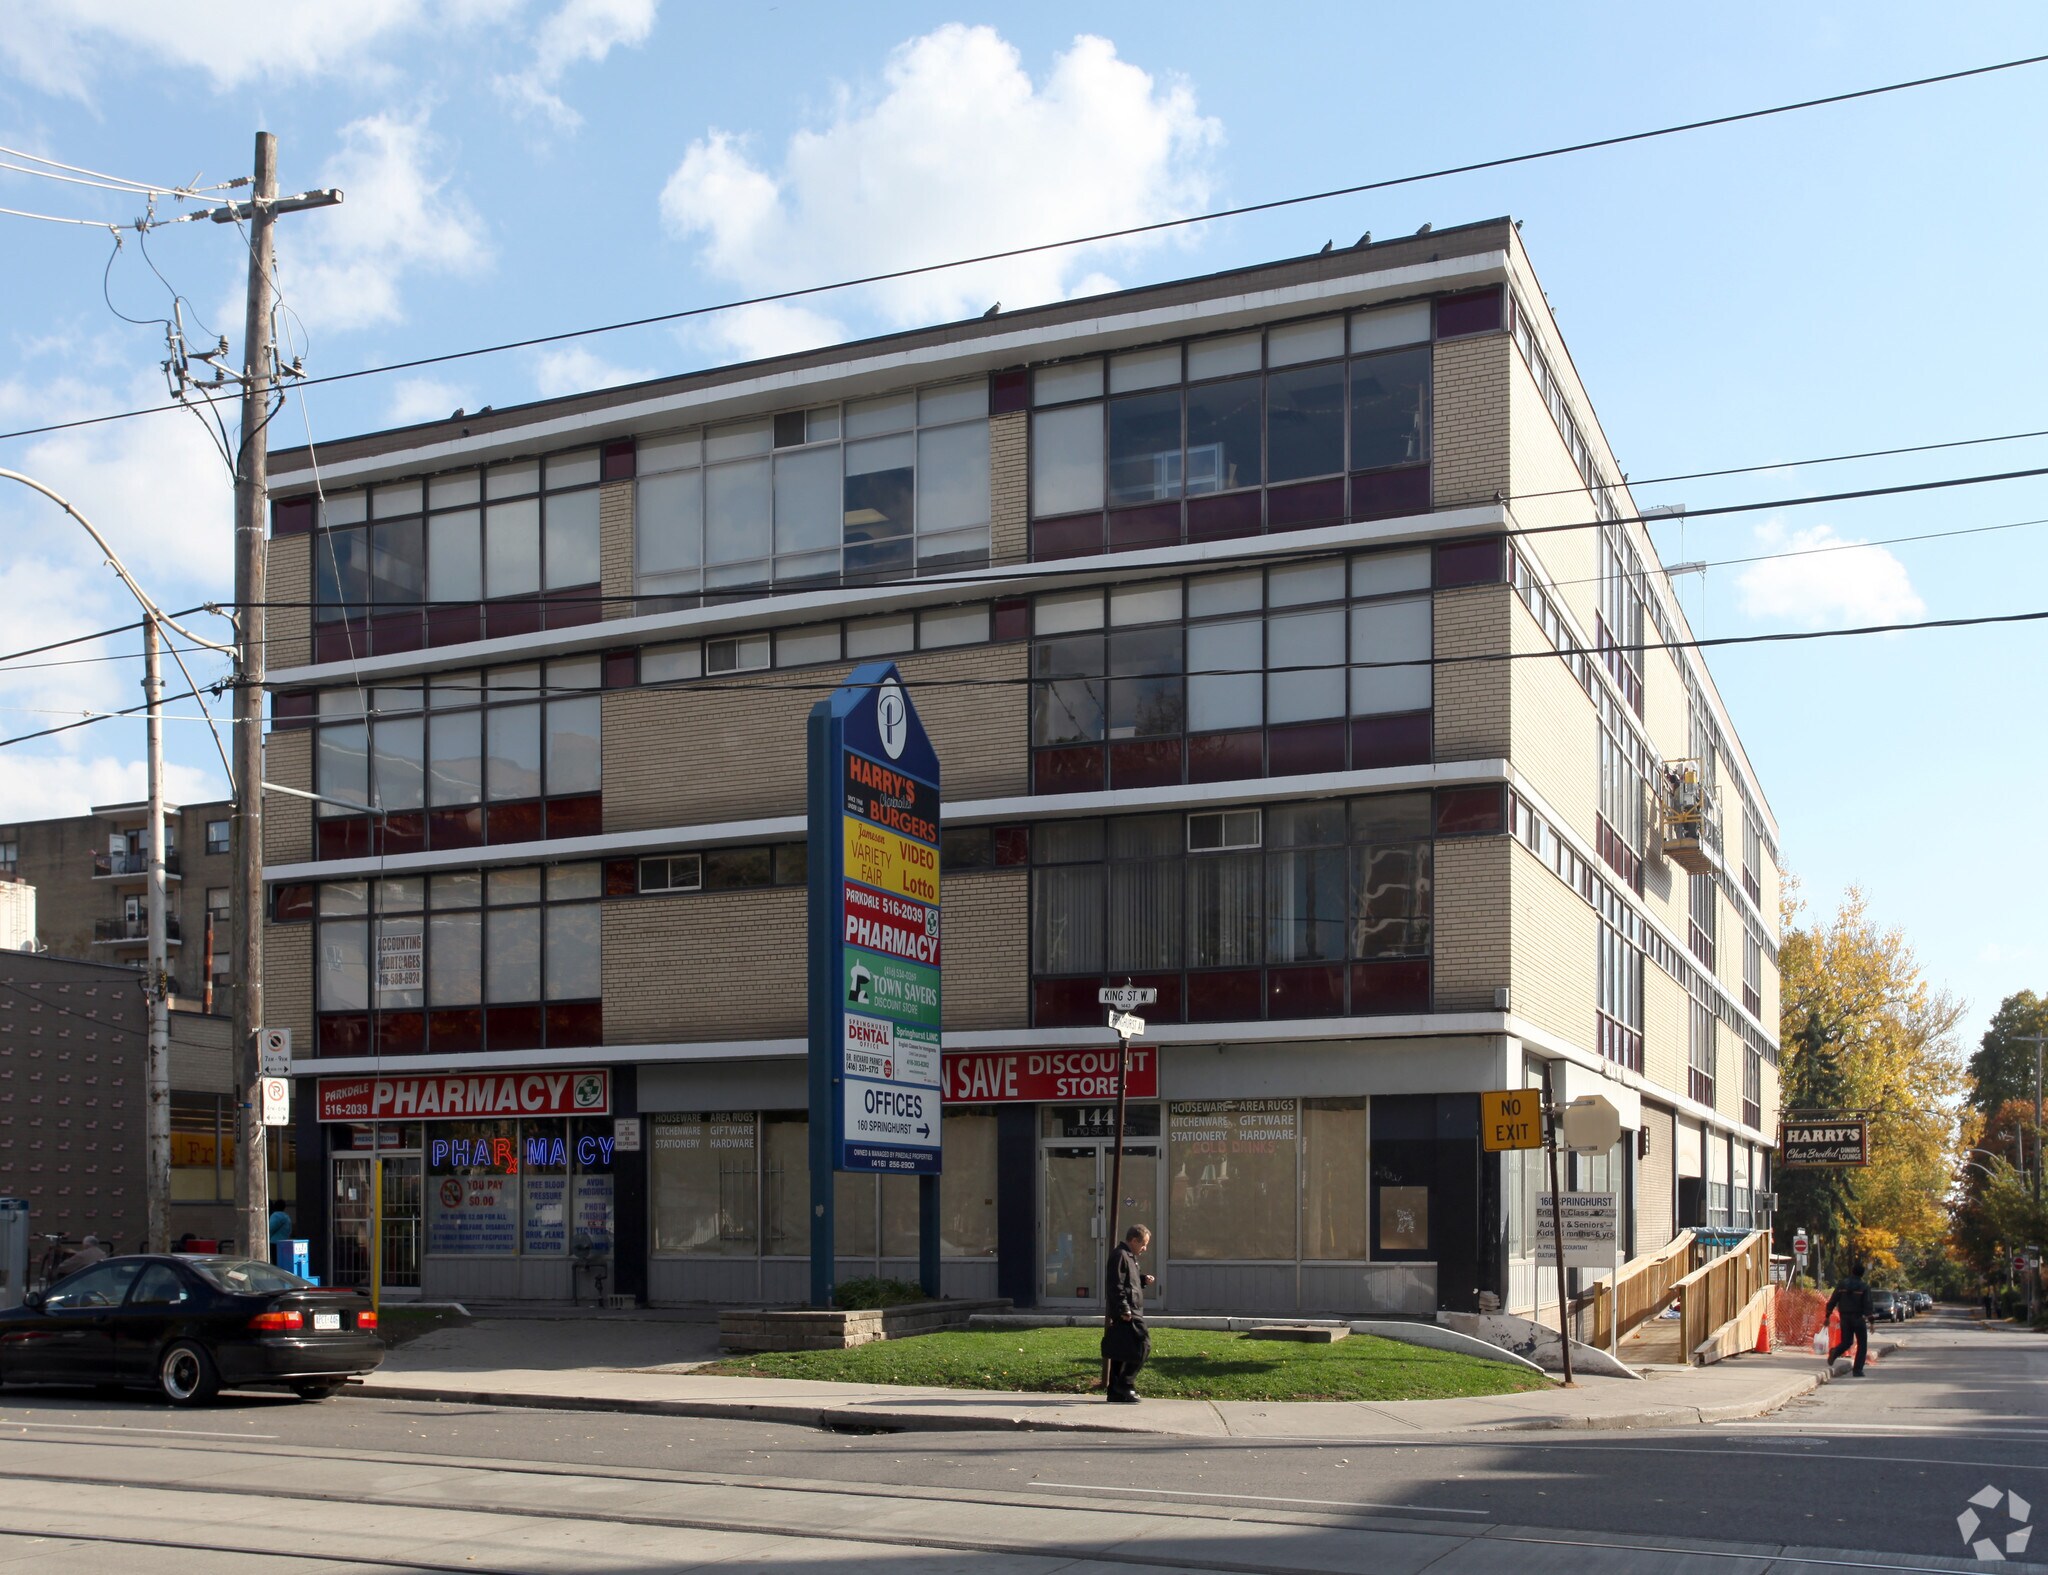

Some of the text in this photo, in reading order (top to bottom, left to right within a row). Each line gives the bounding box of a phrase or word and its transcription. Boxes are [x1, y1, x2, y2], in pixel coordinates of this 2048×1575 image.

[850, 755, 916, 804] HARRY'S
[870, 800, 937, 842] BURGERS
[858, 822, 885, 845] Jameson
[851, 840, 892, 869] VARIETY
[899, 841, 934, 870] VIDEO
[861, 864, 883, 887] FAIR
[903, 870, 934, 899] Lotto
[846, 888, 923, 924] PARKDALE 516-2039
[378, 935, 422, 951] ACCOUNTING
[845, 914, 938, 963] PHARMACY
[872, 974, 937, 1007] TOWN SAVERS
[1104, 991, 1149, 1001] KING ST. W.
[874, 996, 918, 1014] DISCOUNT STORE
[849, 1019, 889, 1031] SPRINGHURST
[849, 1025, 889, 1046] DENTAL
[860, 1041, 879, 1050] OFFICE
[853, 1054, 869, 1065] RICHARD
[957, 1057, 1018, 1099] SAVE
[325, 1083, 369, 1102] PARKDALE
[1056, 1076, 1119, 1096] STORE
[371, 1075, 569, 1115] PHARMACY
[325, 1103, 368, 1115] 516-2039
[864, 1089, 922, 1119] OFFICES
[1171, 1099, 1294, 1113] HOUSEWARE AREA RUGS
[1501, 1099, 1521, 1116] NO
[655, 1112, 754, 1123] HOUSEWARE AREA RUGS
[1078, 1109, 1127, 1126] 144
[1171, 1115, 1294, 1127] KITCHENWARE GIFTWARE
[655, 1125, 754, 1136] KITCHENWARE GIFTWARE
[858, 1120, 912, 1135] 160 SPRINGHURST
[1495, 1124, 1529, 1141] EXIT
[1171, 1129, 1294, 1142] STATIONERY HARDWARE
[1786, 1128, 1860, 1143] HARRY'S
[655, 1138, 754, 1149] STATIONERY HARDWARE
[1231, 1141, 1275, 1154] DRINKS
[1786, 1147, 1840, 1159] Char Broiled
[871, 1160, 886, 1168] (416)
[467, 1180, 503, 1191] YOU PAY
[527, 1181, 565, 1189] FREE BLOOD
[586, 1178, 604, 1187] AVON
[530, 1192, 562, 1200] PRESSURE
[578, 1187, 613, 1196] PRODUCTS
[584, 1202, 606, 1211] PHOTO
[1541, 1197, 1613, 1206] 160 PRINGHURST
[1536, 1209, 1566, 1217] Engh
[528, 1219, 538, 1227] ALL
[544, 1231, 565, 1239] PLANS
[529, 1242, 562, 1250] ACCEPTED
